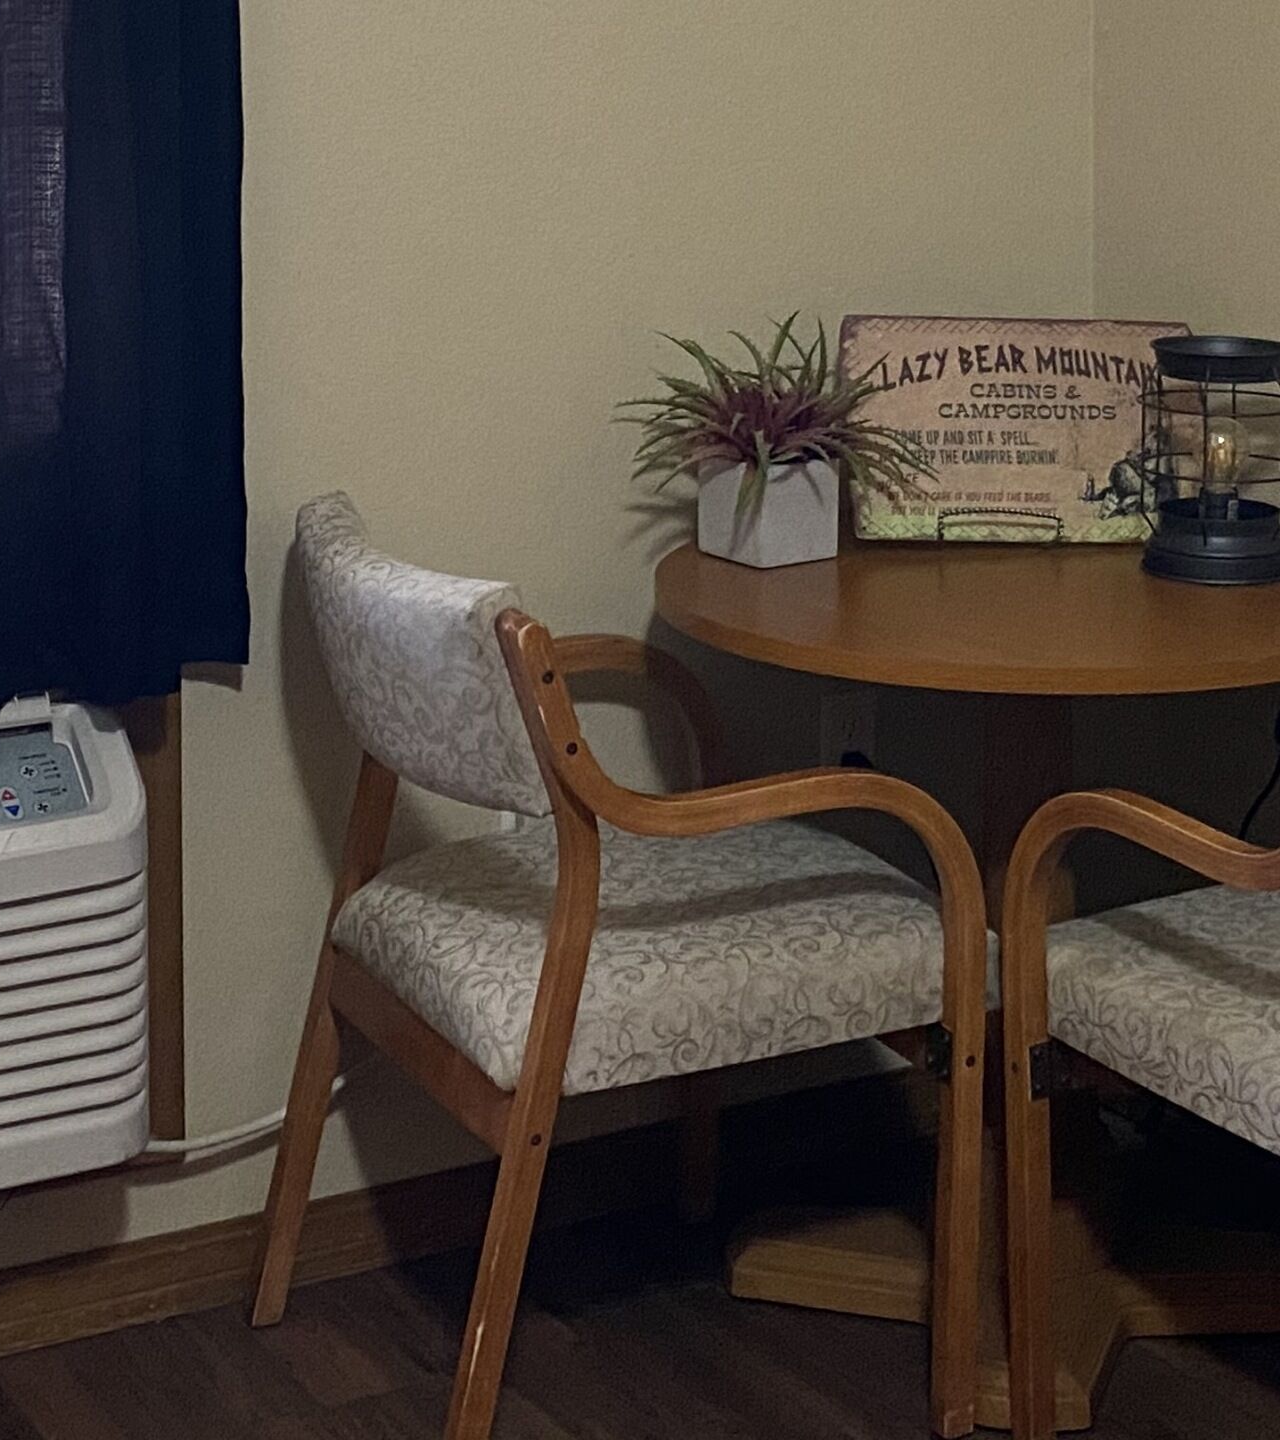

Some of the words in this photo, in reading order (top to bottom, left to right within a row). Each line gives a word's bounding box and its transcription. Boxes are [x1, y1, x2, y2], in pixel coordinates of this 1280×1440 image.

[880, 347, 949, 391] LAZY
[958, 343, 1028, 377] BEAR
[969, 383, 1058, 400] CABINS
[1065, 385, 1082, 400] &
[938, 403, 1117, 420] CAMPGROUNDS
[926, 430, 940, 446] UP
[943, 430, 964, 446] AND
[967, 430, 983, 446] SIT
[986, 430, 995, 446] A
[940, 449, 959, 465] THE
[961, 449, 1013, 465] CAMPFIRE
